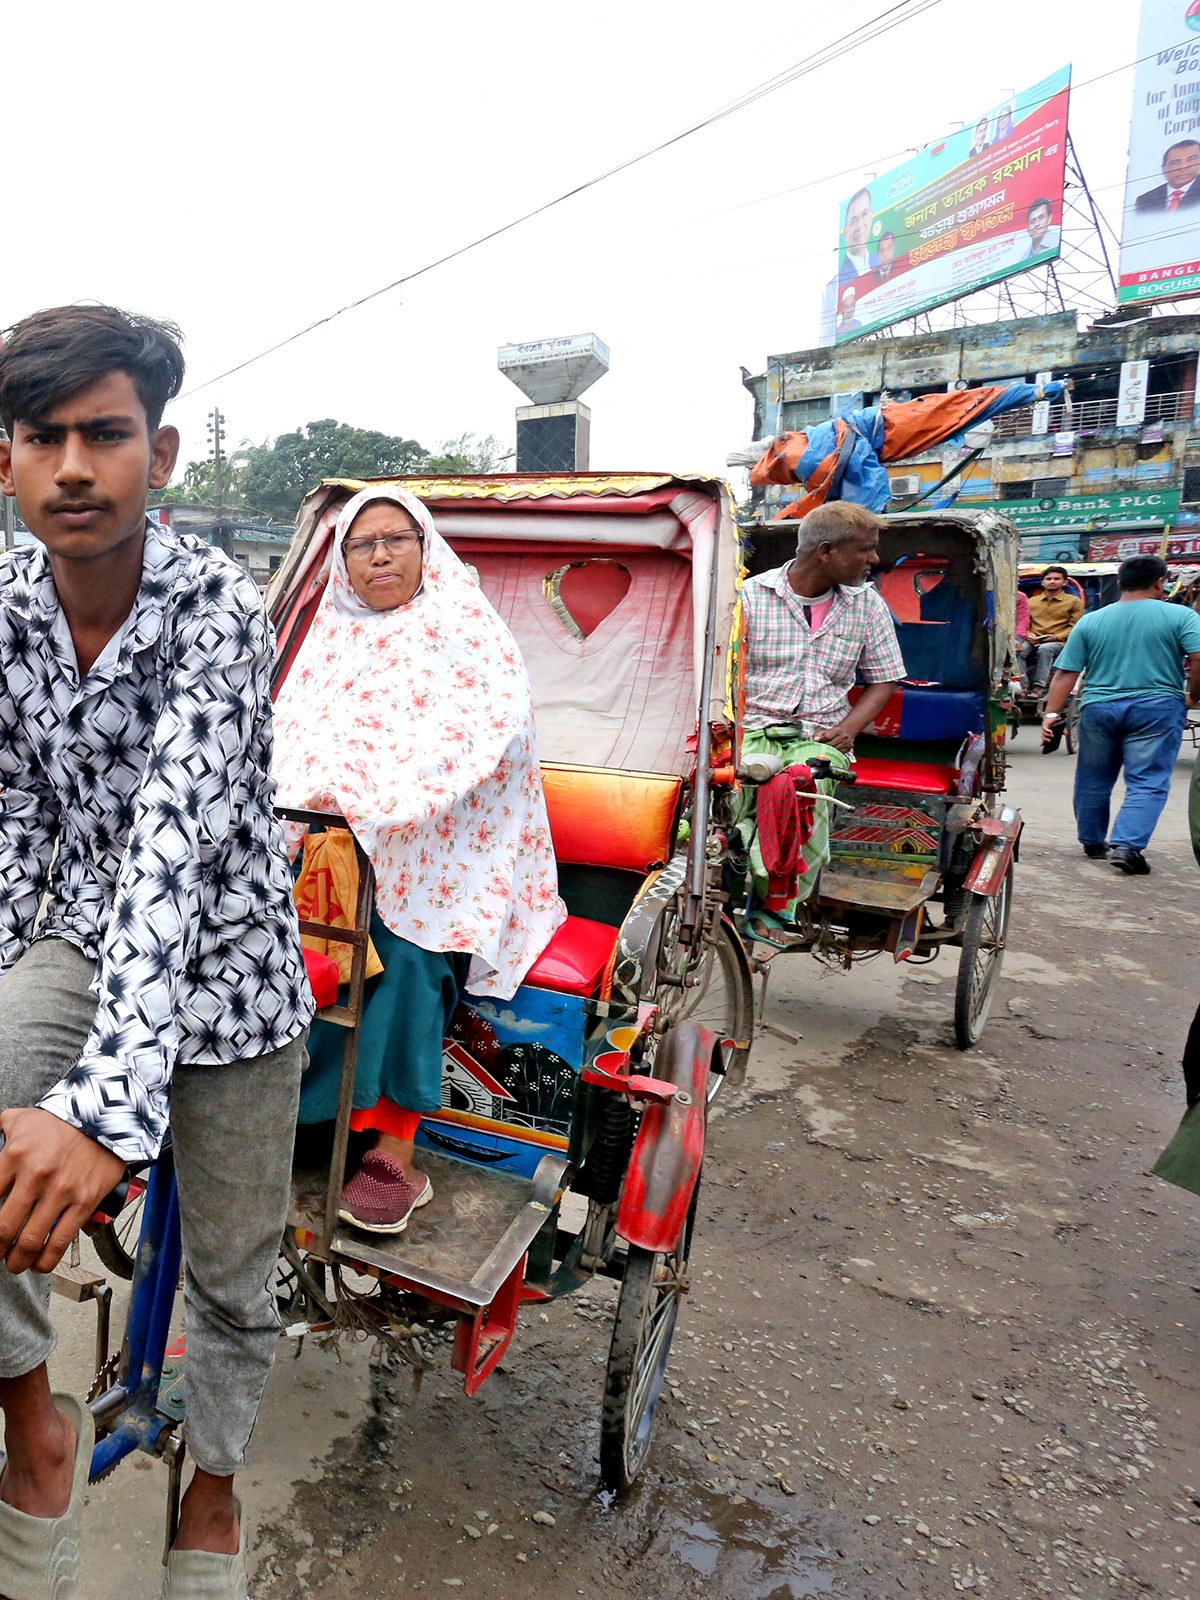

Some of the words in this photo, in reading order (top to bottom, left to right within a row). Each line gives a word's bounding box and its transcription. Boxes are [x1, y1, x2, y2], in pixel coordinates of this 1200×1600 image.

[1176, 59, 1200, 75] Bo
[1146, 90, 1166, 106] for
[1158, 102, 1171, 119] of
[904, 201, 938, 228] জনাব
[942, 175, 988, 208] তারেক
[992, 146, 1044, 184] রহমান
[1139, 265, 1200, 282] BANGL
[1057, 500, 1111, 511] Bank
[1118, 494, 1166, 508] PLC.
